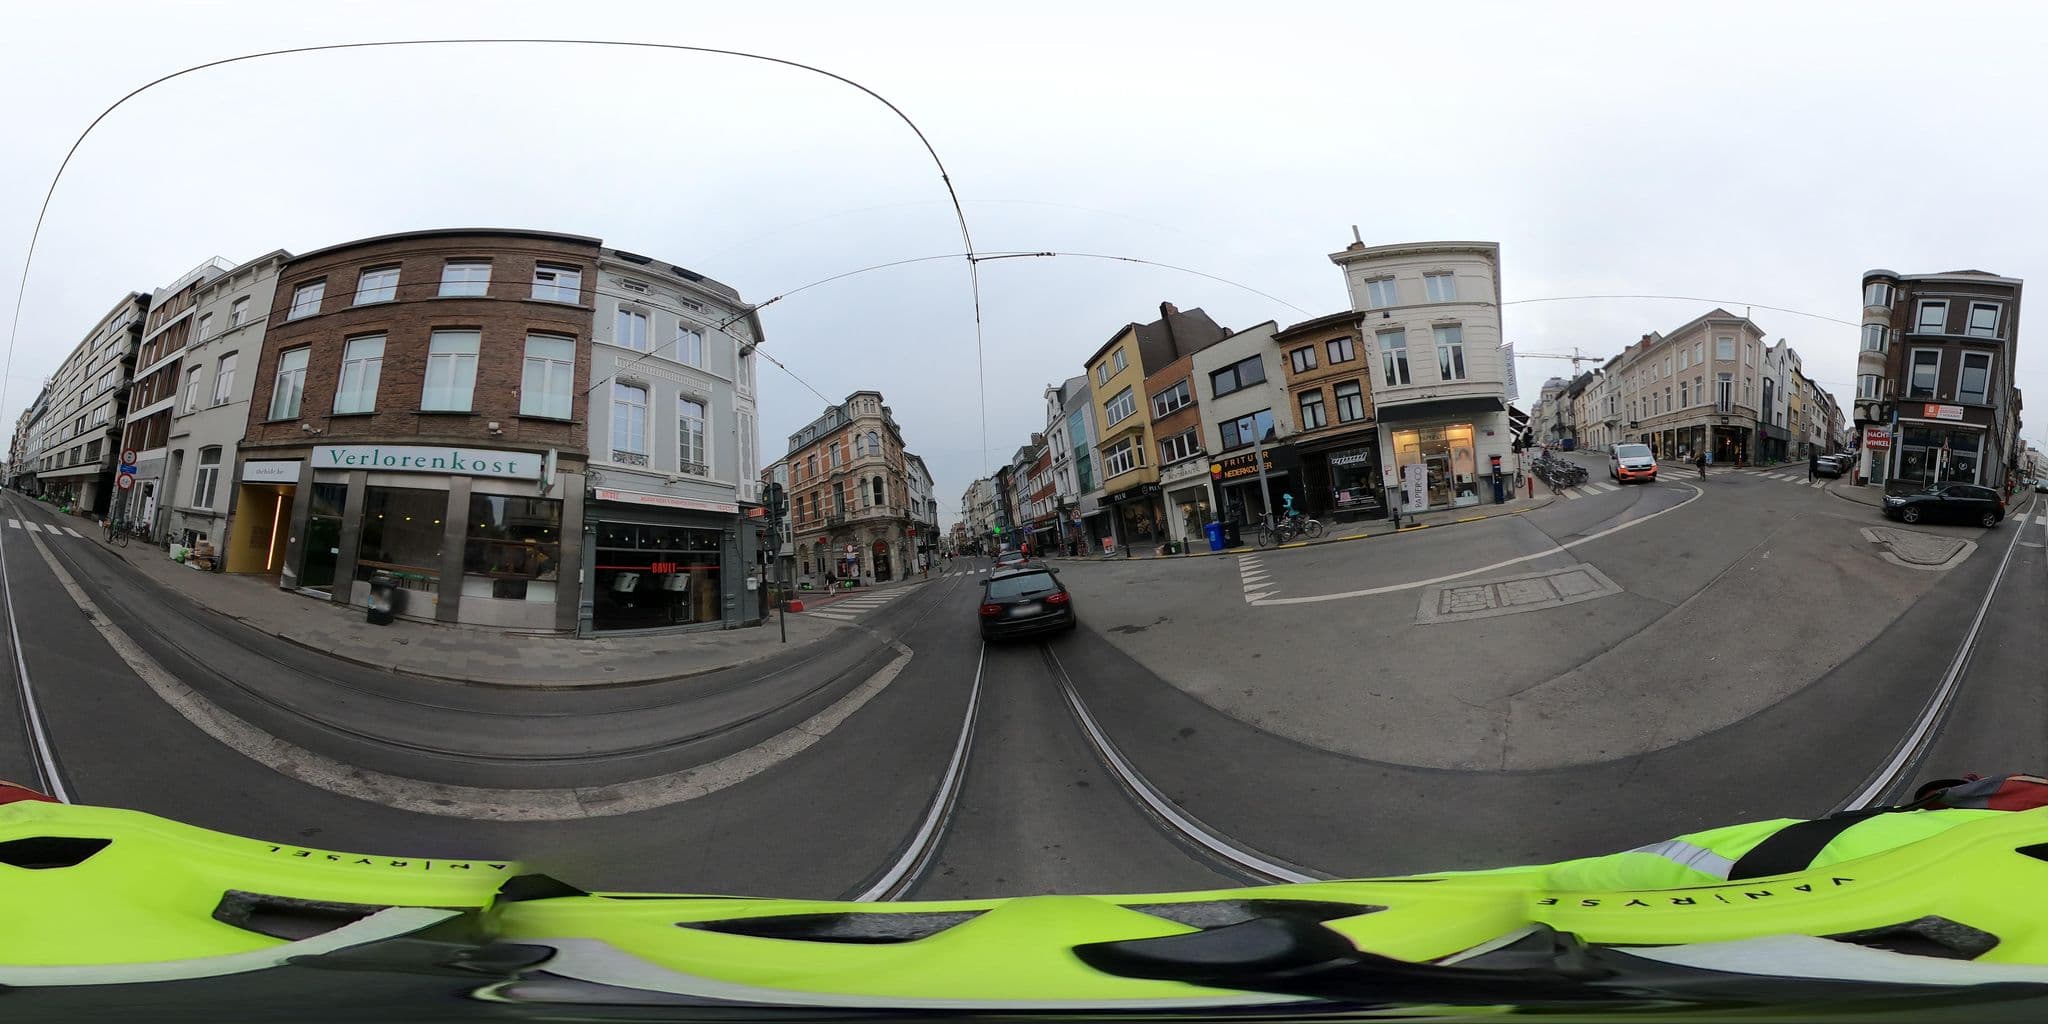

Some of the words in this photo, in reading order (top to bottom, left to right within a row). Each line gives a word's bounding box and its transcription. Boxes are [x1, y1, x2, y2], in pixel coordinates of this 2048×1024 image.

[329, 448, 519, 475] Verlorenkost
[1223, 450, 1269, 467] FRITUR
[1224, 461, 1273, 478] NEDERKOUER
[652, 562, 677, 574] BAVET
